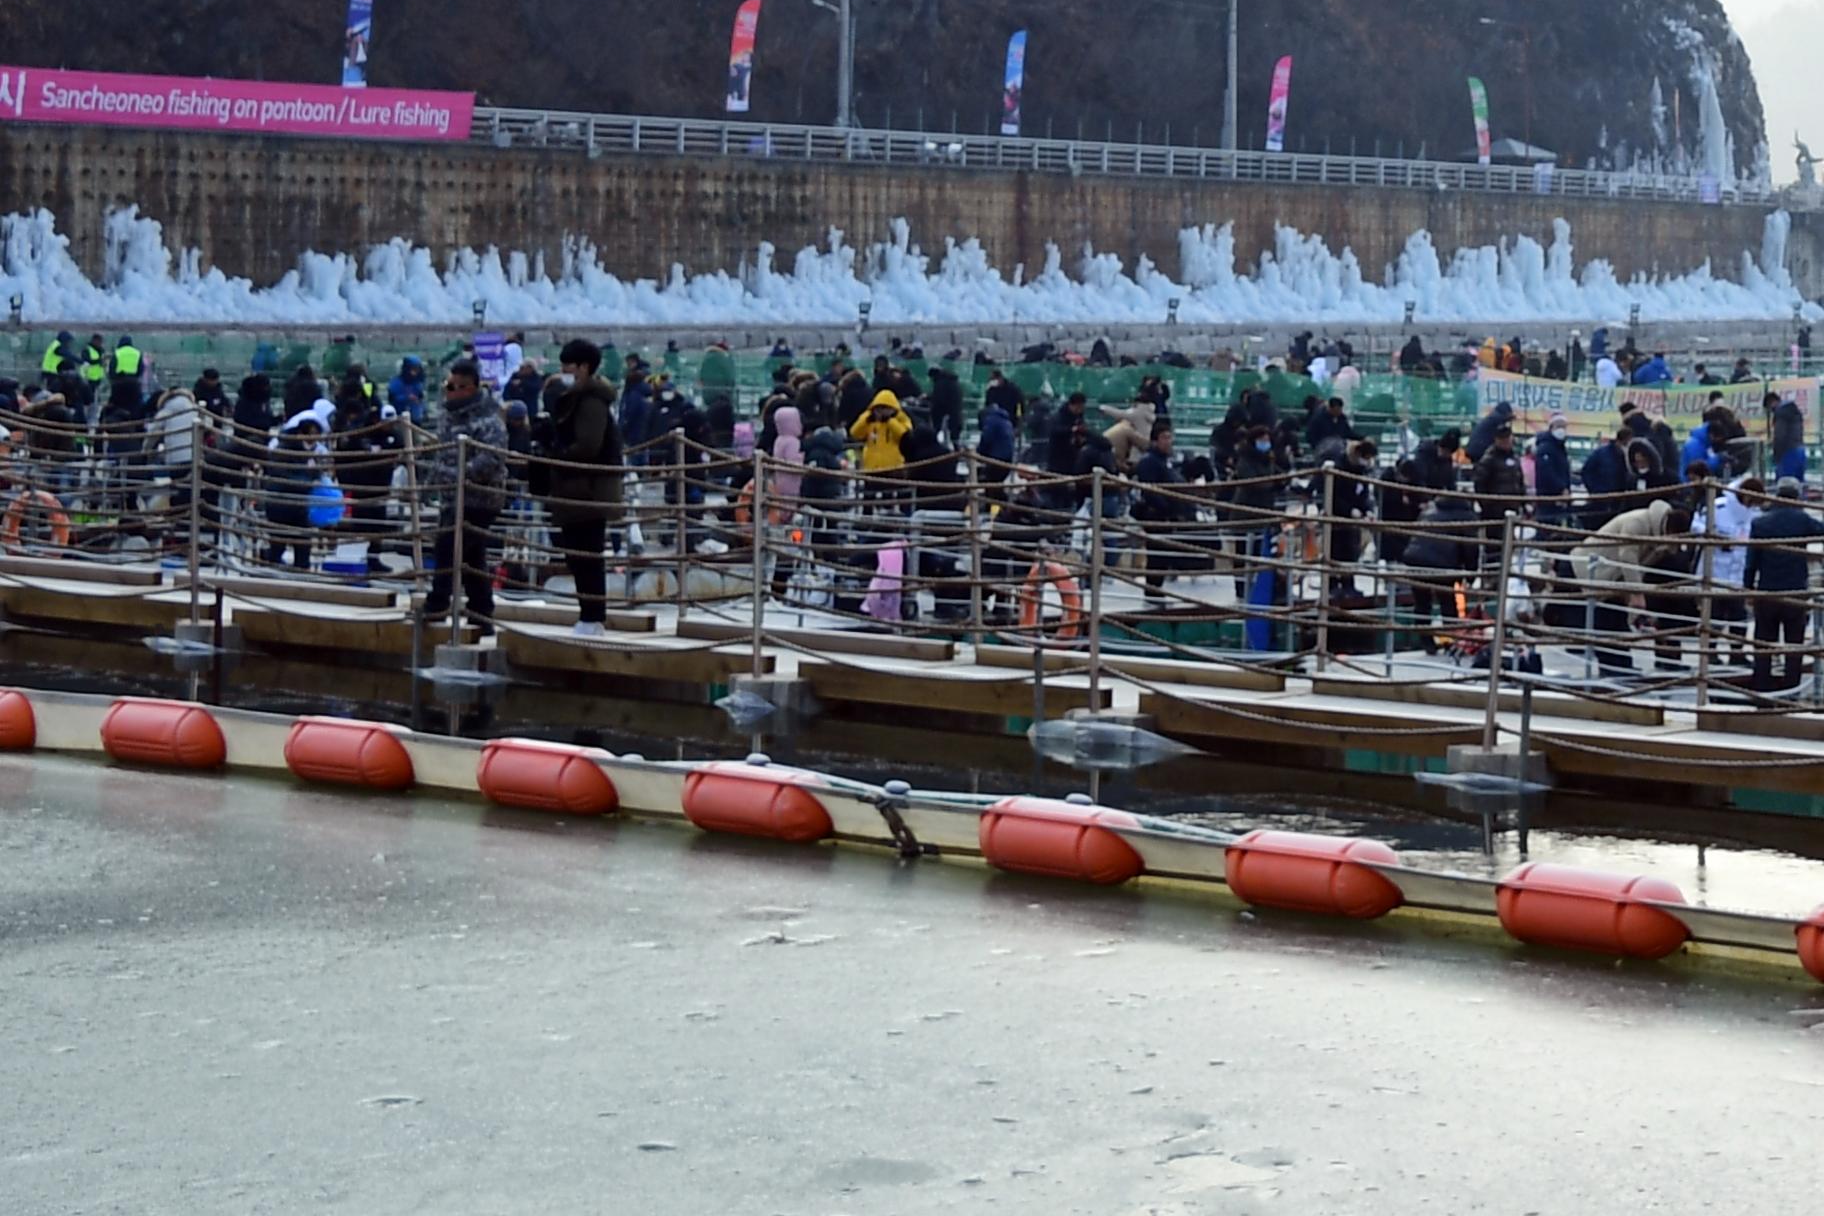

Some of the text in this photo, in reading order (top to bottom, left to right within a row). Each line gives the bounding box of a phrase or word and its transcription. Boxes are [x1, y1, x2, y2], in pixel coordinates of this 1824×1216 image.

[41, 81, 164, 113] Sancheoneo
[167, 88, 231, 124] fishing
[233, 98, 257, 119] on
[394, 100, 451, 134] fishing
